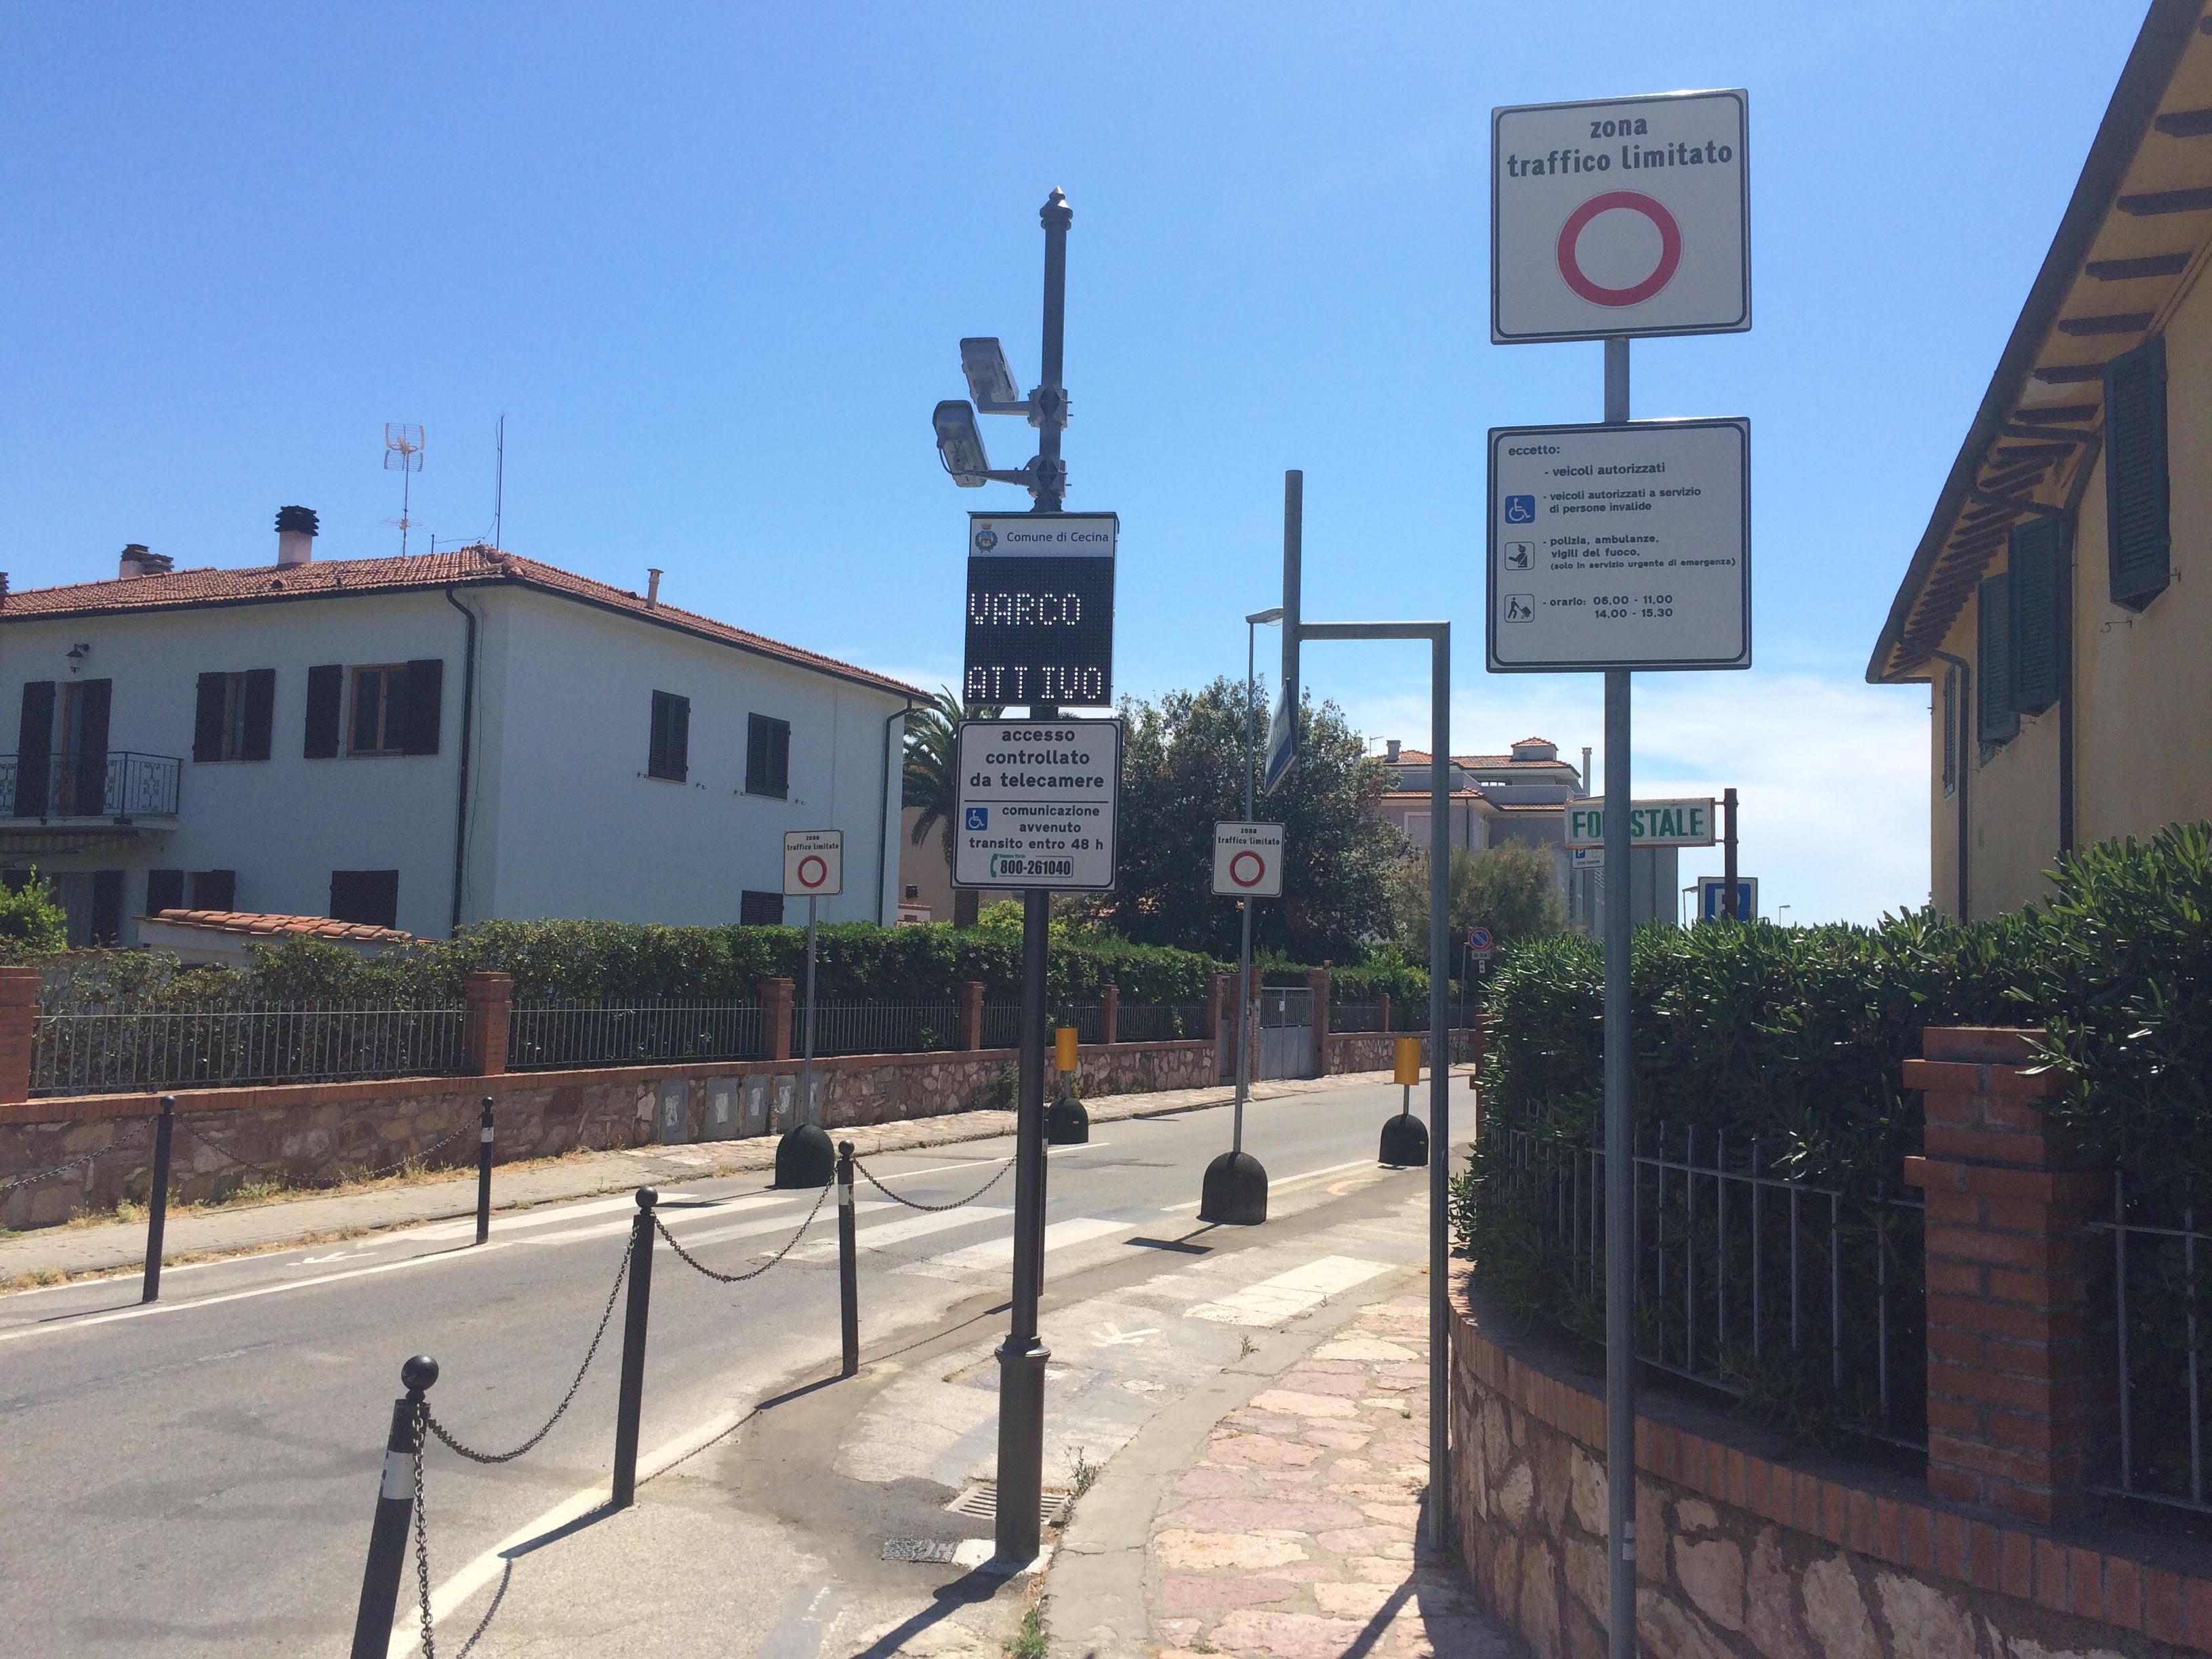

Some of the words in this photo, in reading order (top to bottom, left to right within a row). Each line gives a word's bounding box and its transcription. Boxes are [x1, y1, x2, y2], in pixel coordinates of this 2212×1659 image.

[1590, 118, 1648, 138] zona
[1507, 149, 1611, 178] traffico
[1622, 140, 1732, 169] limitato
[1508, 445, 1561, 456] eccetto:
[1552, 465, 1593, 477] veicoli
[1597, 462, 1666, 475] autorizzati
[1550, 490, 1585, 501] veicoli
[1588, 489, 1645, 499] autorizzati
[1659, 487, 1701, 497] servizio
[1549, 504, 1559, 513] di
[1563, 504, 1606, 515] persone
[1610, 501, 1652, 512] invalide
[1007, 532, 1053, 542] Comune
[1057, 532, 1067, 542] di
[1071, 532, 1109, 542] Cecina
[1550, 536, 1590, 548] polizia,
[1551, 549, 1578, 559] vigili
[1582, 548, 1600, 557] del
[1551, 562, 1574, 571] (solo
[1589, 560, 1624, 569] servizio
[1628, 559, 1664, 569] urgente
[1668, 558, 1677, 567] di
[1680, 557, 1736, 568] emergenza)
[1549, 597, 1586, 607] orario:
[1593, 596, 1629, 605] 06.00
[1643, 595, 1673, 604] 11.00
[971, 594, 1080, 626] VARCO
[1594, 609, 1627, 619] 14.00
[1642, 609, 1673, 618] 15.30
[968, 666, 1101, 699] ATTIVO
[1002, 730, 1076, 742] accesso
[985, 750, 1090, 764] controllato
[970, 772, 991, 787] da
[1000, 772, 1105, 787] telecamere
[1002, 804, 1100, 817] comunicazione
[1019, 822, 1082, 833] avvenuto
[1572, 808, 1704, 838] FOSTALE
[969, 837, 1023, 849] transito
[1029, 838, 1065, 849] entro
[1071, 838, 1089, 850] 48
[1096, 839, 1103, 850] h
[1218, 836, 1247, 844] traffico
[1250, 837, 1280, 845] limitato
[1000, 859, 1071, 876] 800-261040
